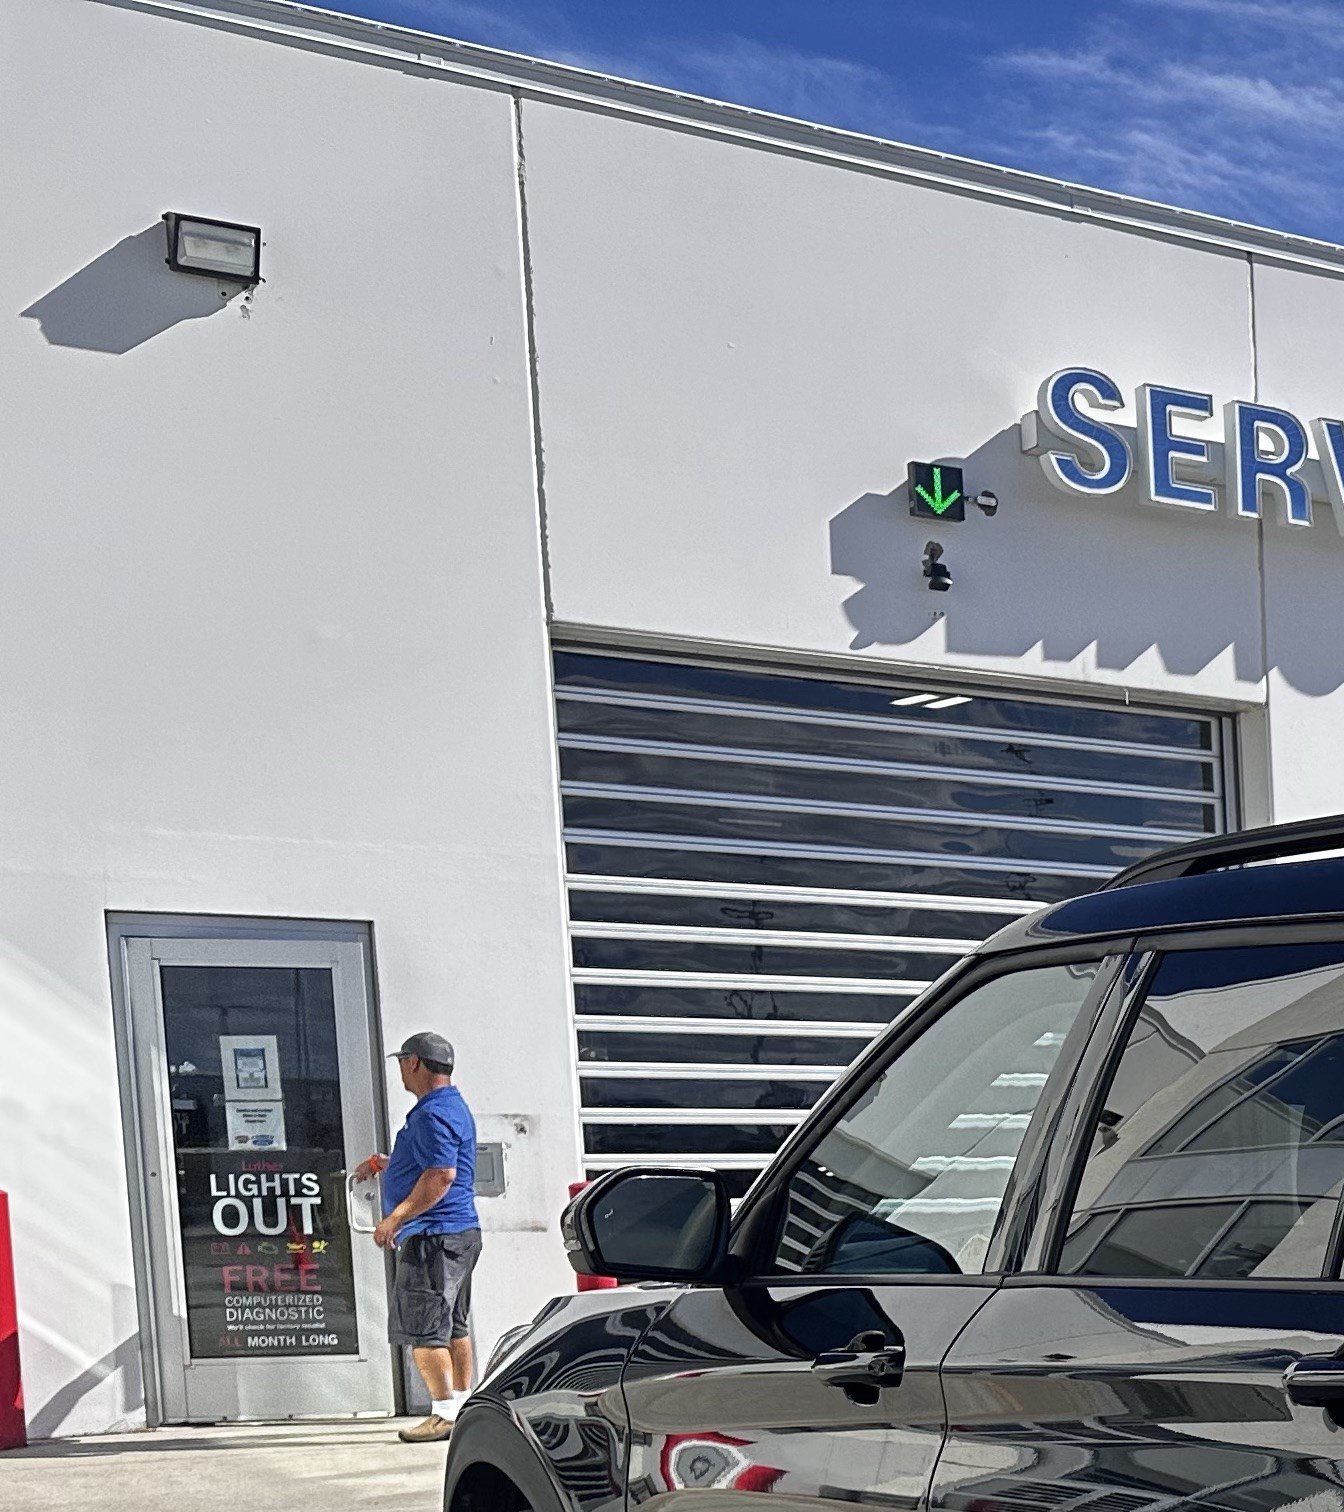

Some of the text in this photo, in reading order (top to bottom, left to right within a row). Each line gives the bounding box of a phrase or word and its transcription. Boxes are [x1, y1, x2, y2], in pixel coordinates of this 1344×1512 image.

[210, 1172, 320, 1197] LIGHTS
[212, 1197, 322, 1236] OUT
[222, 1263, 321, 1293] FREE
[225, 1294, 323, 1307] COMPUTERIZED
[226, 1306, 325, 1321] DIAGNOSTIC
[247, 1335, 296, 1347] MONTH
[302, 1333, 339, 1346] LONG
